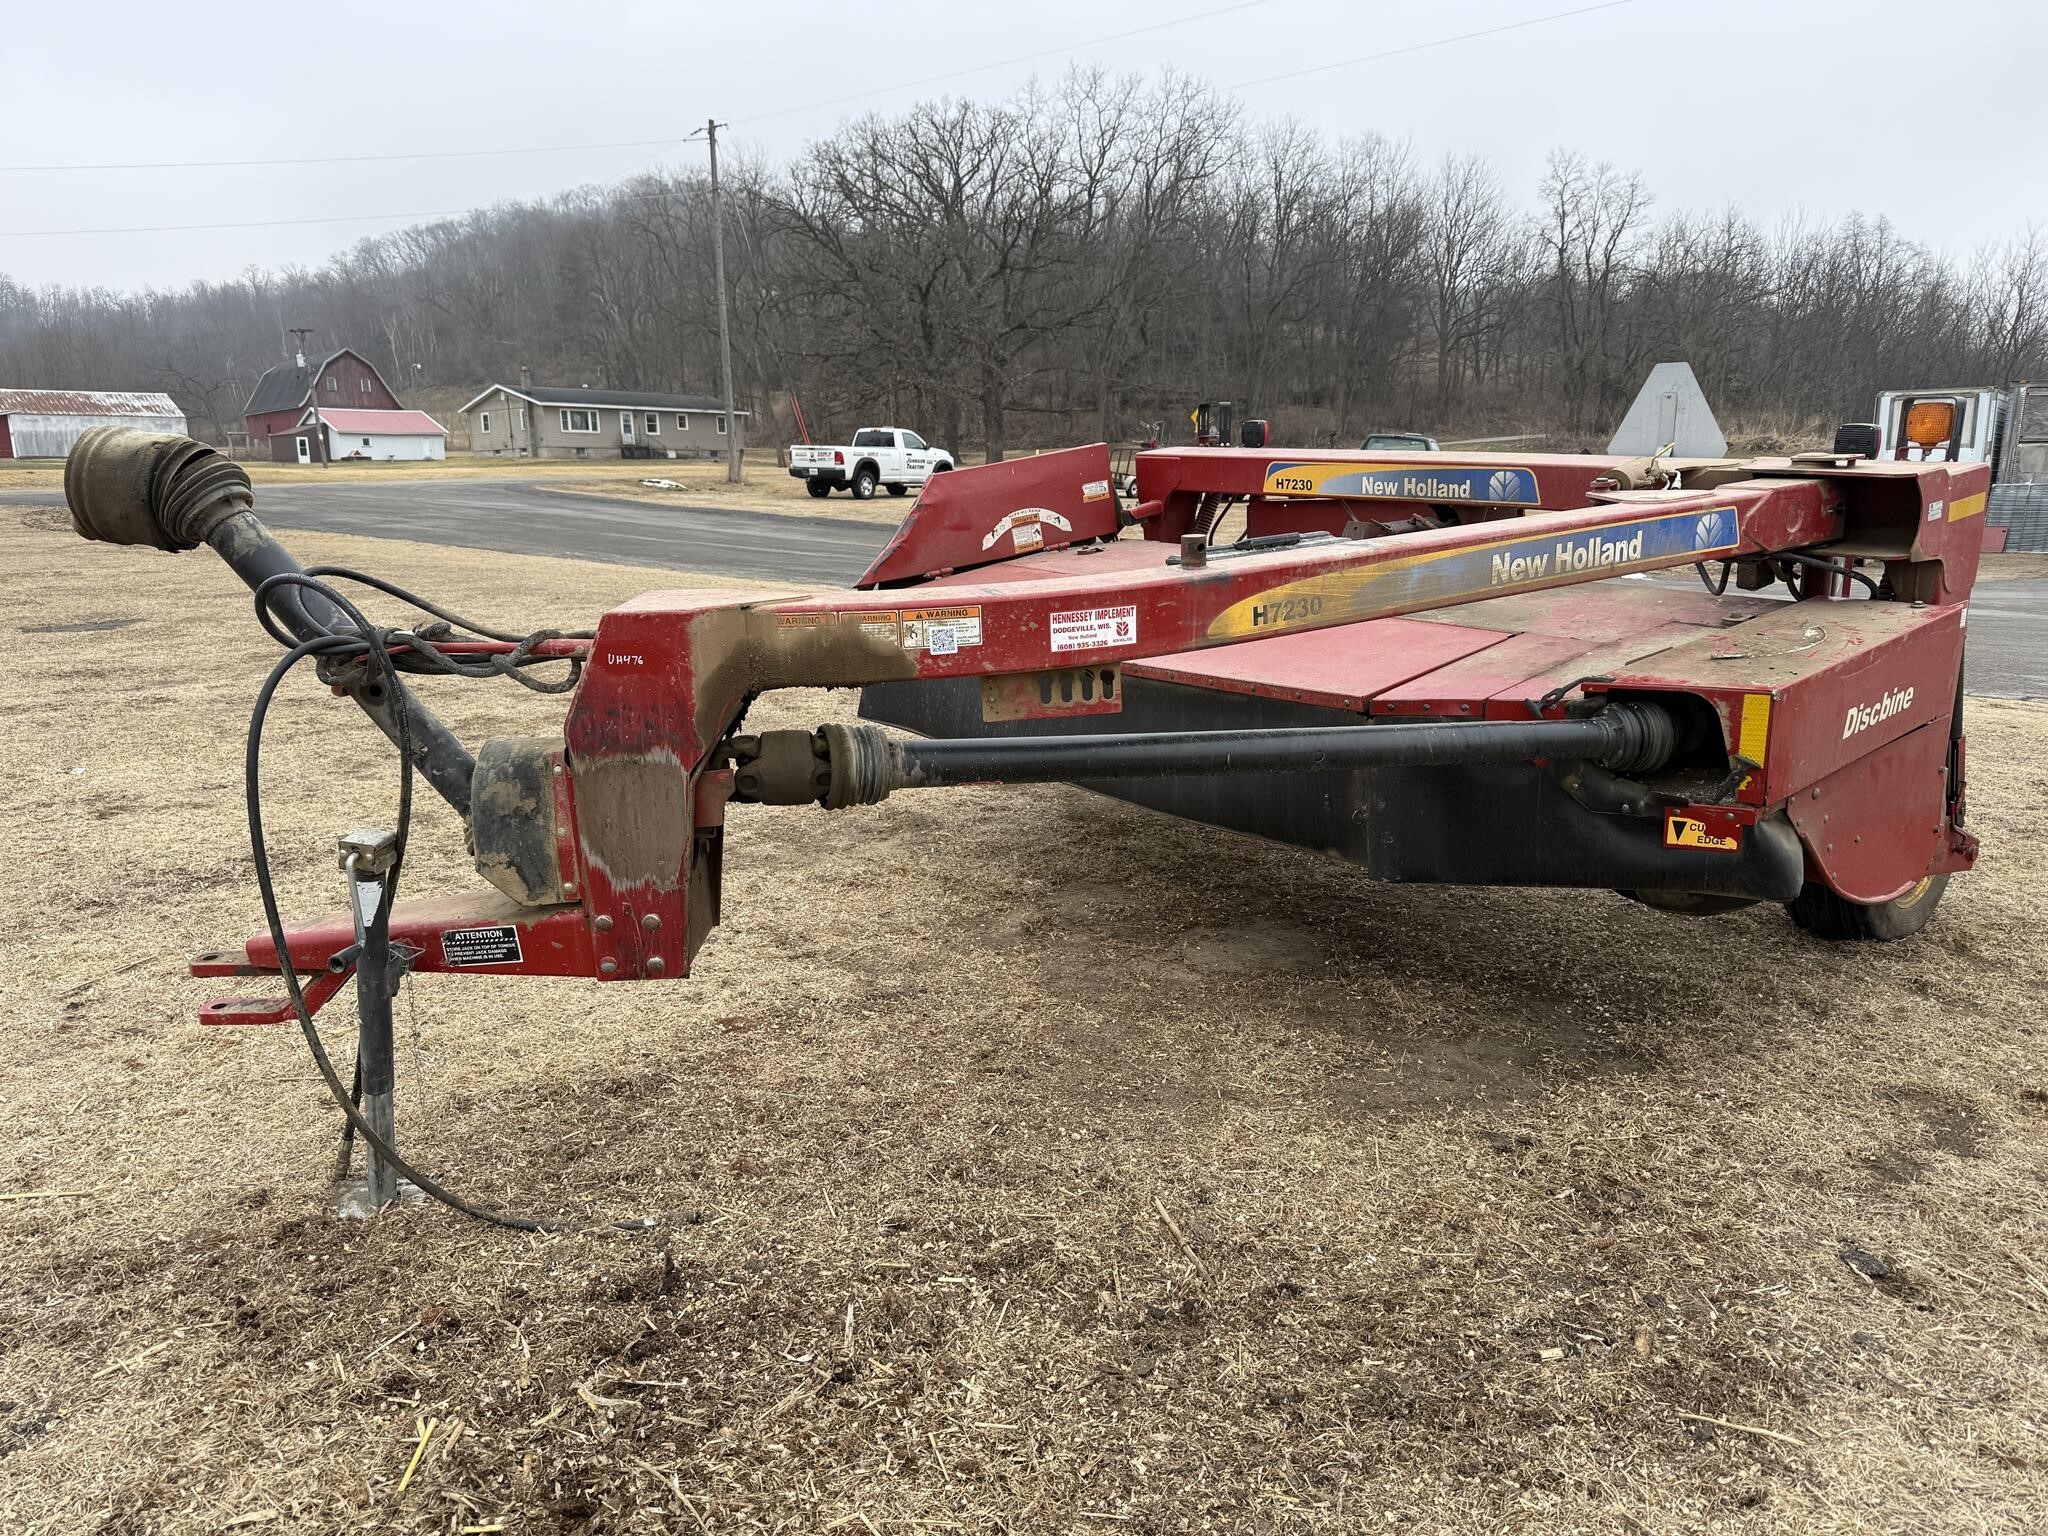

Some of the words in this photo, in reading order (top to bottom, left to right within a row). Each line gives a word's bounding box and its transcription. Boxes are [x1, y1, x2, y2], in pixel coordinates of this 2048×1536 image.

[1276, 478, 1312, 491] H7230
[1361, 476, 1398, 496] New
[1403, 478, 1470, 499] Holland
[1490, 552, 1549, 584] New
[1555, 530, 1643, 573] Holland
[926, 609, 968, 618] WARNING
[1052, 611, 1093, 624] HENNESSEY
[1094, 606, 1135, 620] IMPLEMENT
[1252, 598, 1322, 627] H7230
[776, 616, 822, 626] WARNING
[1052, 624, 1096, 634] DODGEVILLE,
[1056, 642, 1076, 651] (608)
[1076, 640, 1108, 648] 935-3326
[608, 653, 644, 666] UH476
[1842, 686, 1914, 740] Discbine
[1697, 836, 1726, 846] EDGE
[455, 930, 503, 940] ATTENTION
